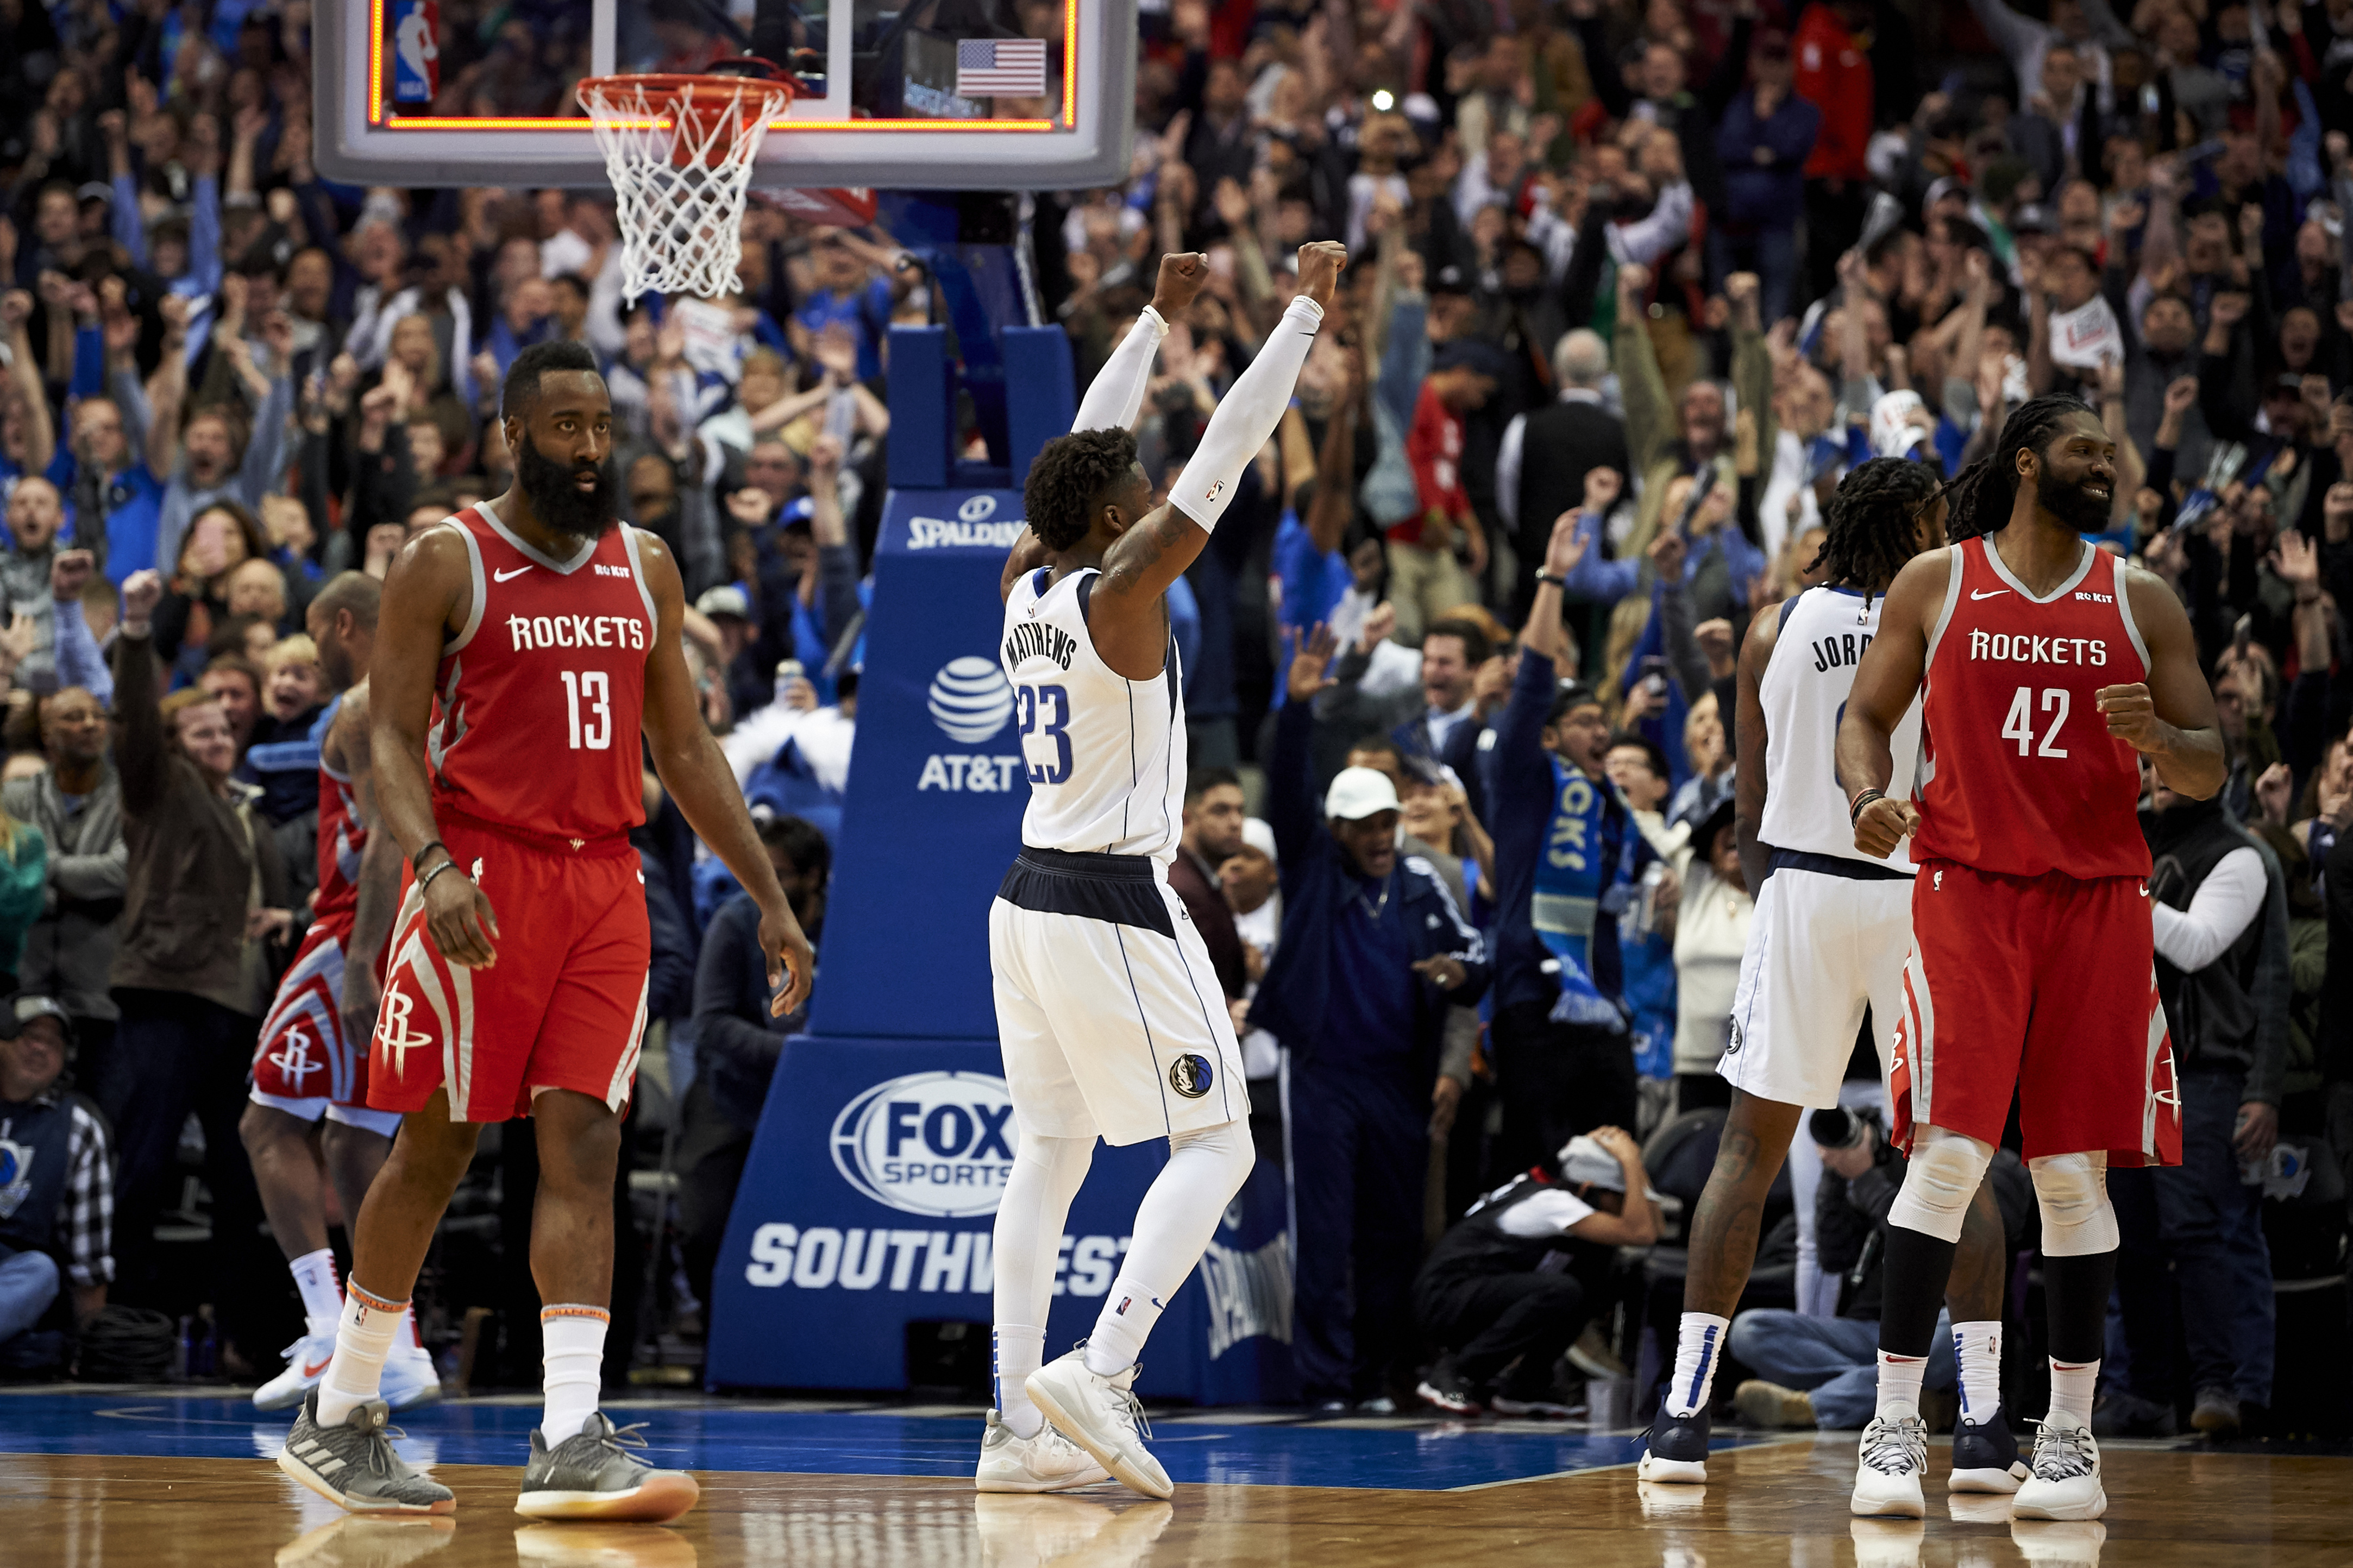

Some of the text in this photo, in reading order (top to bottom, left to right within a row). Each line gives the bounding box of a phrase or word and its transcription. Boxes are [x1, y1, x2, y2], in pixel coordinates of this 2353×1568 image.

[505, 613, 644, 652] ROCKETS
[1006, 622, 1077, 673] MATTHEWS
[1967, 627, 2107, 666] ROCKETS
[561, 670, 612, 750] 13
[1018, 683, 1075, 786] 23
[2001, 686, 2070, 759] 42
[917, 753, 1022, 792] AT&T
[887, 1101, 1014, 1160] FOX
[883, 1162, 1013, 1186] SPORTS
